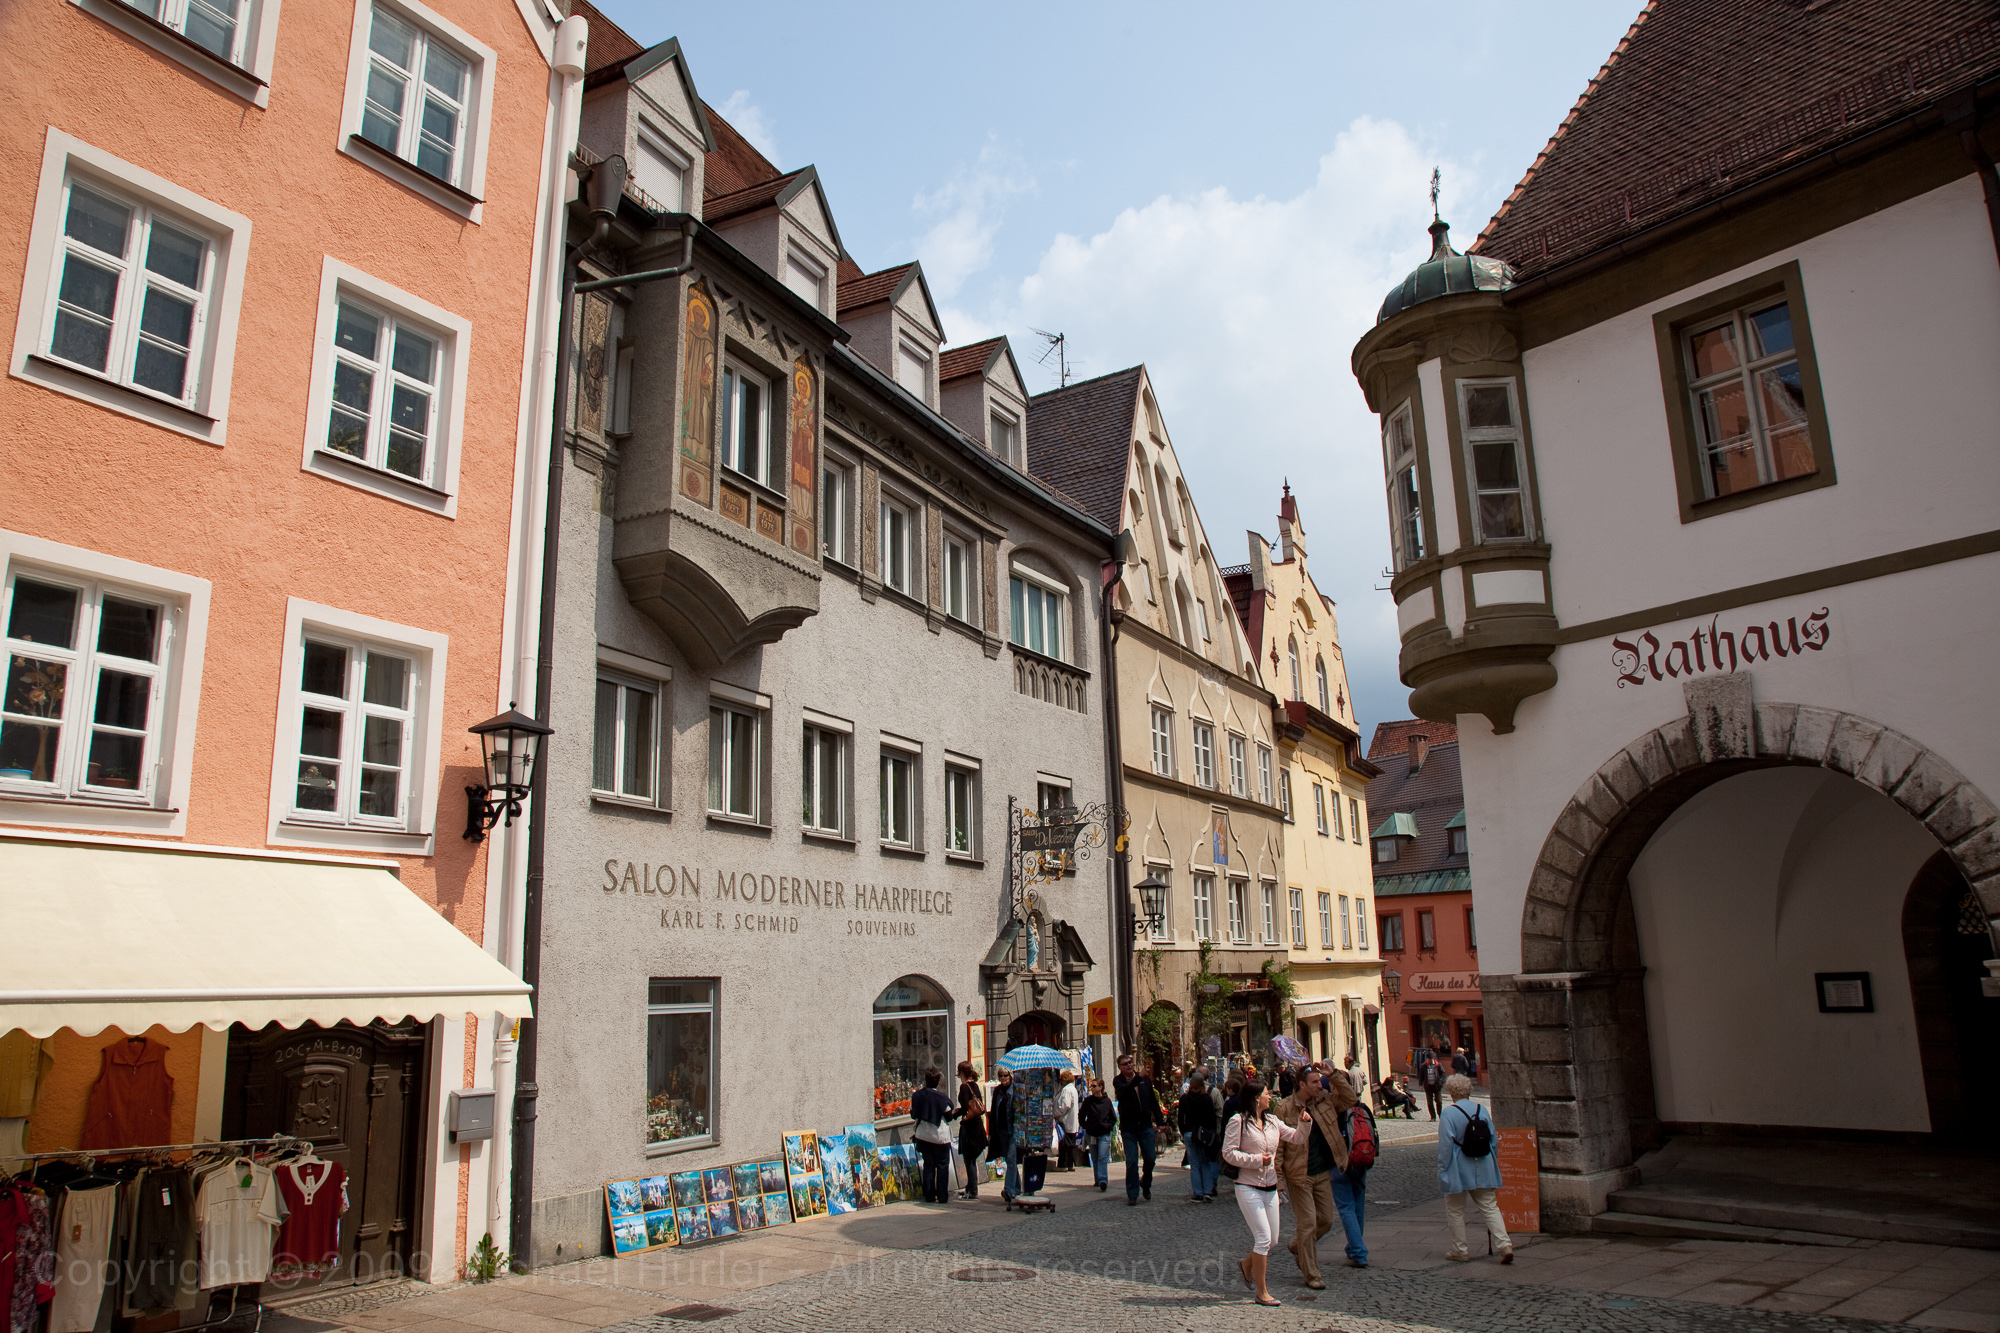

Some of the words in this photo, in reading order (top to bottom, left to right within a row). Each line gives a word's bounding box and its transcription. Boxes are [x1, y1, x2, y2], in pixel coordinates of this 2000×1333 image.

[761, 519, 774, 532] 1975
[1612, 606, 1830, 688] Rathaus
[602, 858, 701, 902] SALON
[716, 869, 846, 910] MODERNER
[854, 883, 953, 916] HAARPFLEGE
[660, 908, 704, 929] KARL
[716, 912, 725, 930] F.
[734, 913, 799, 933] SCHMID
[846, 919, 916, 937] SOUVENIRS
[1417, 975, 1445, 989] Haus
[1447, 976, 1464, 989] des
[1466, 974, 1480, 989] K
